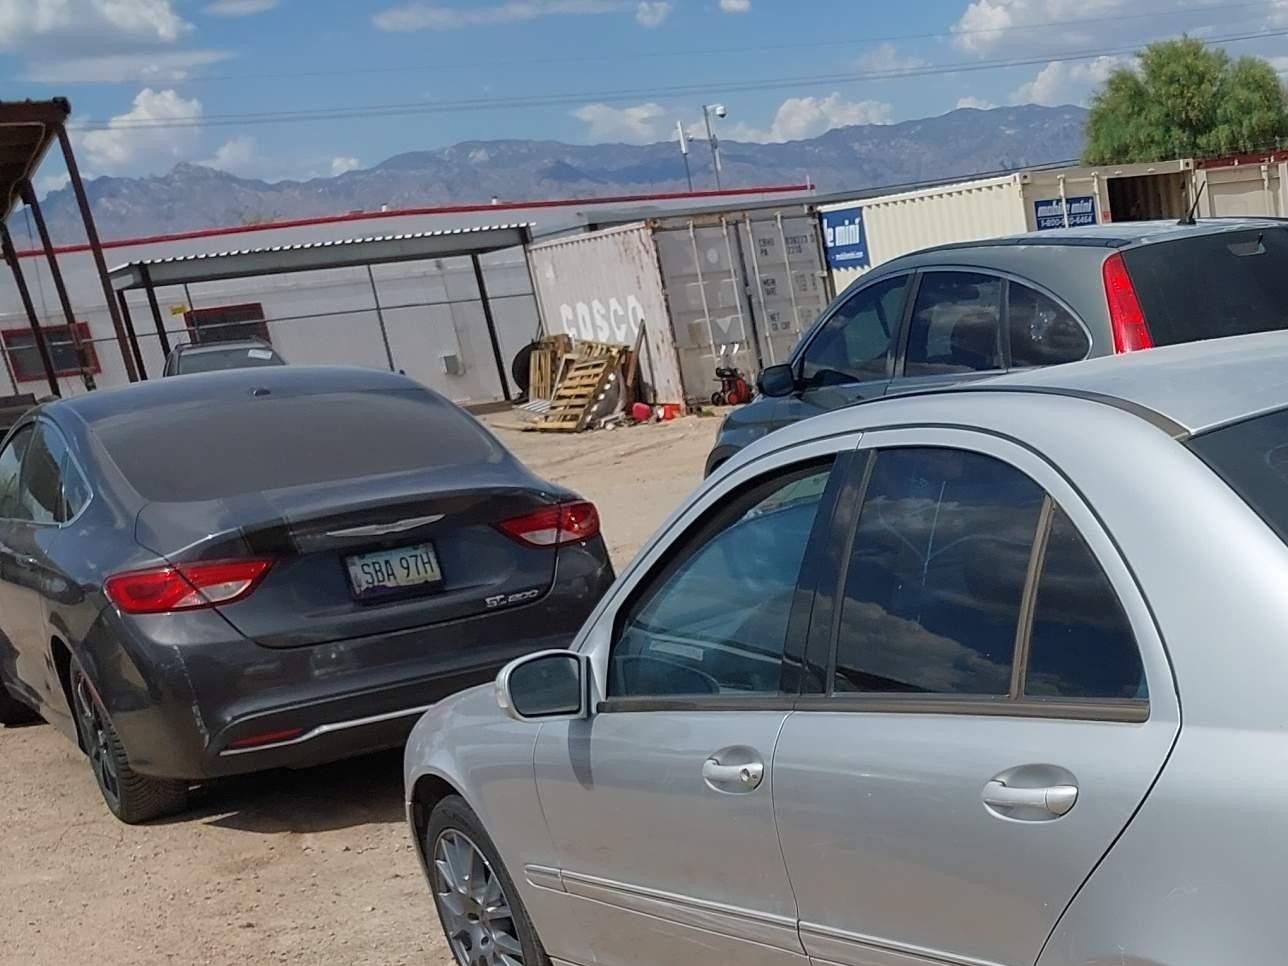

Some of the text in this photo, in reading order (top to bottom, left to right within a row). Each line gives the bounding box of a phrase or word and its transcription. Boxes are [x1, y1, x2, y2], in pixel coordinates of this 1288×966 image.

[1037, 199, 1093, 217] mobie mini
[834, 217, 860, 247] mini
[560, 294, 645, 343] COSCO
[361, 552, 434, 585] SBA 97H
